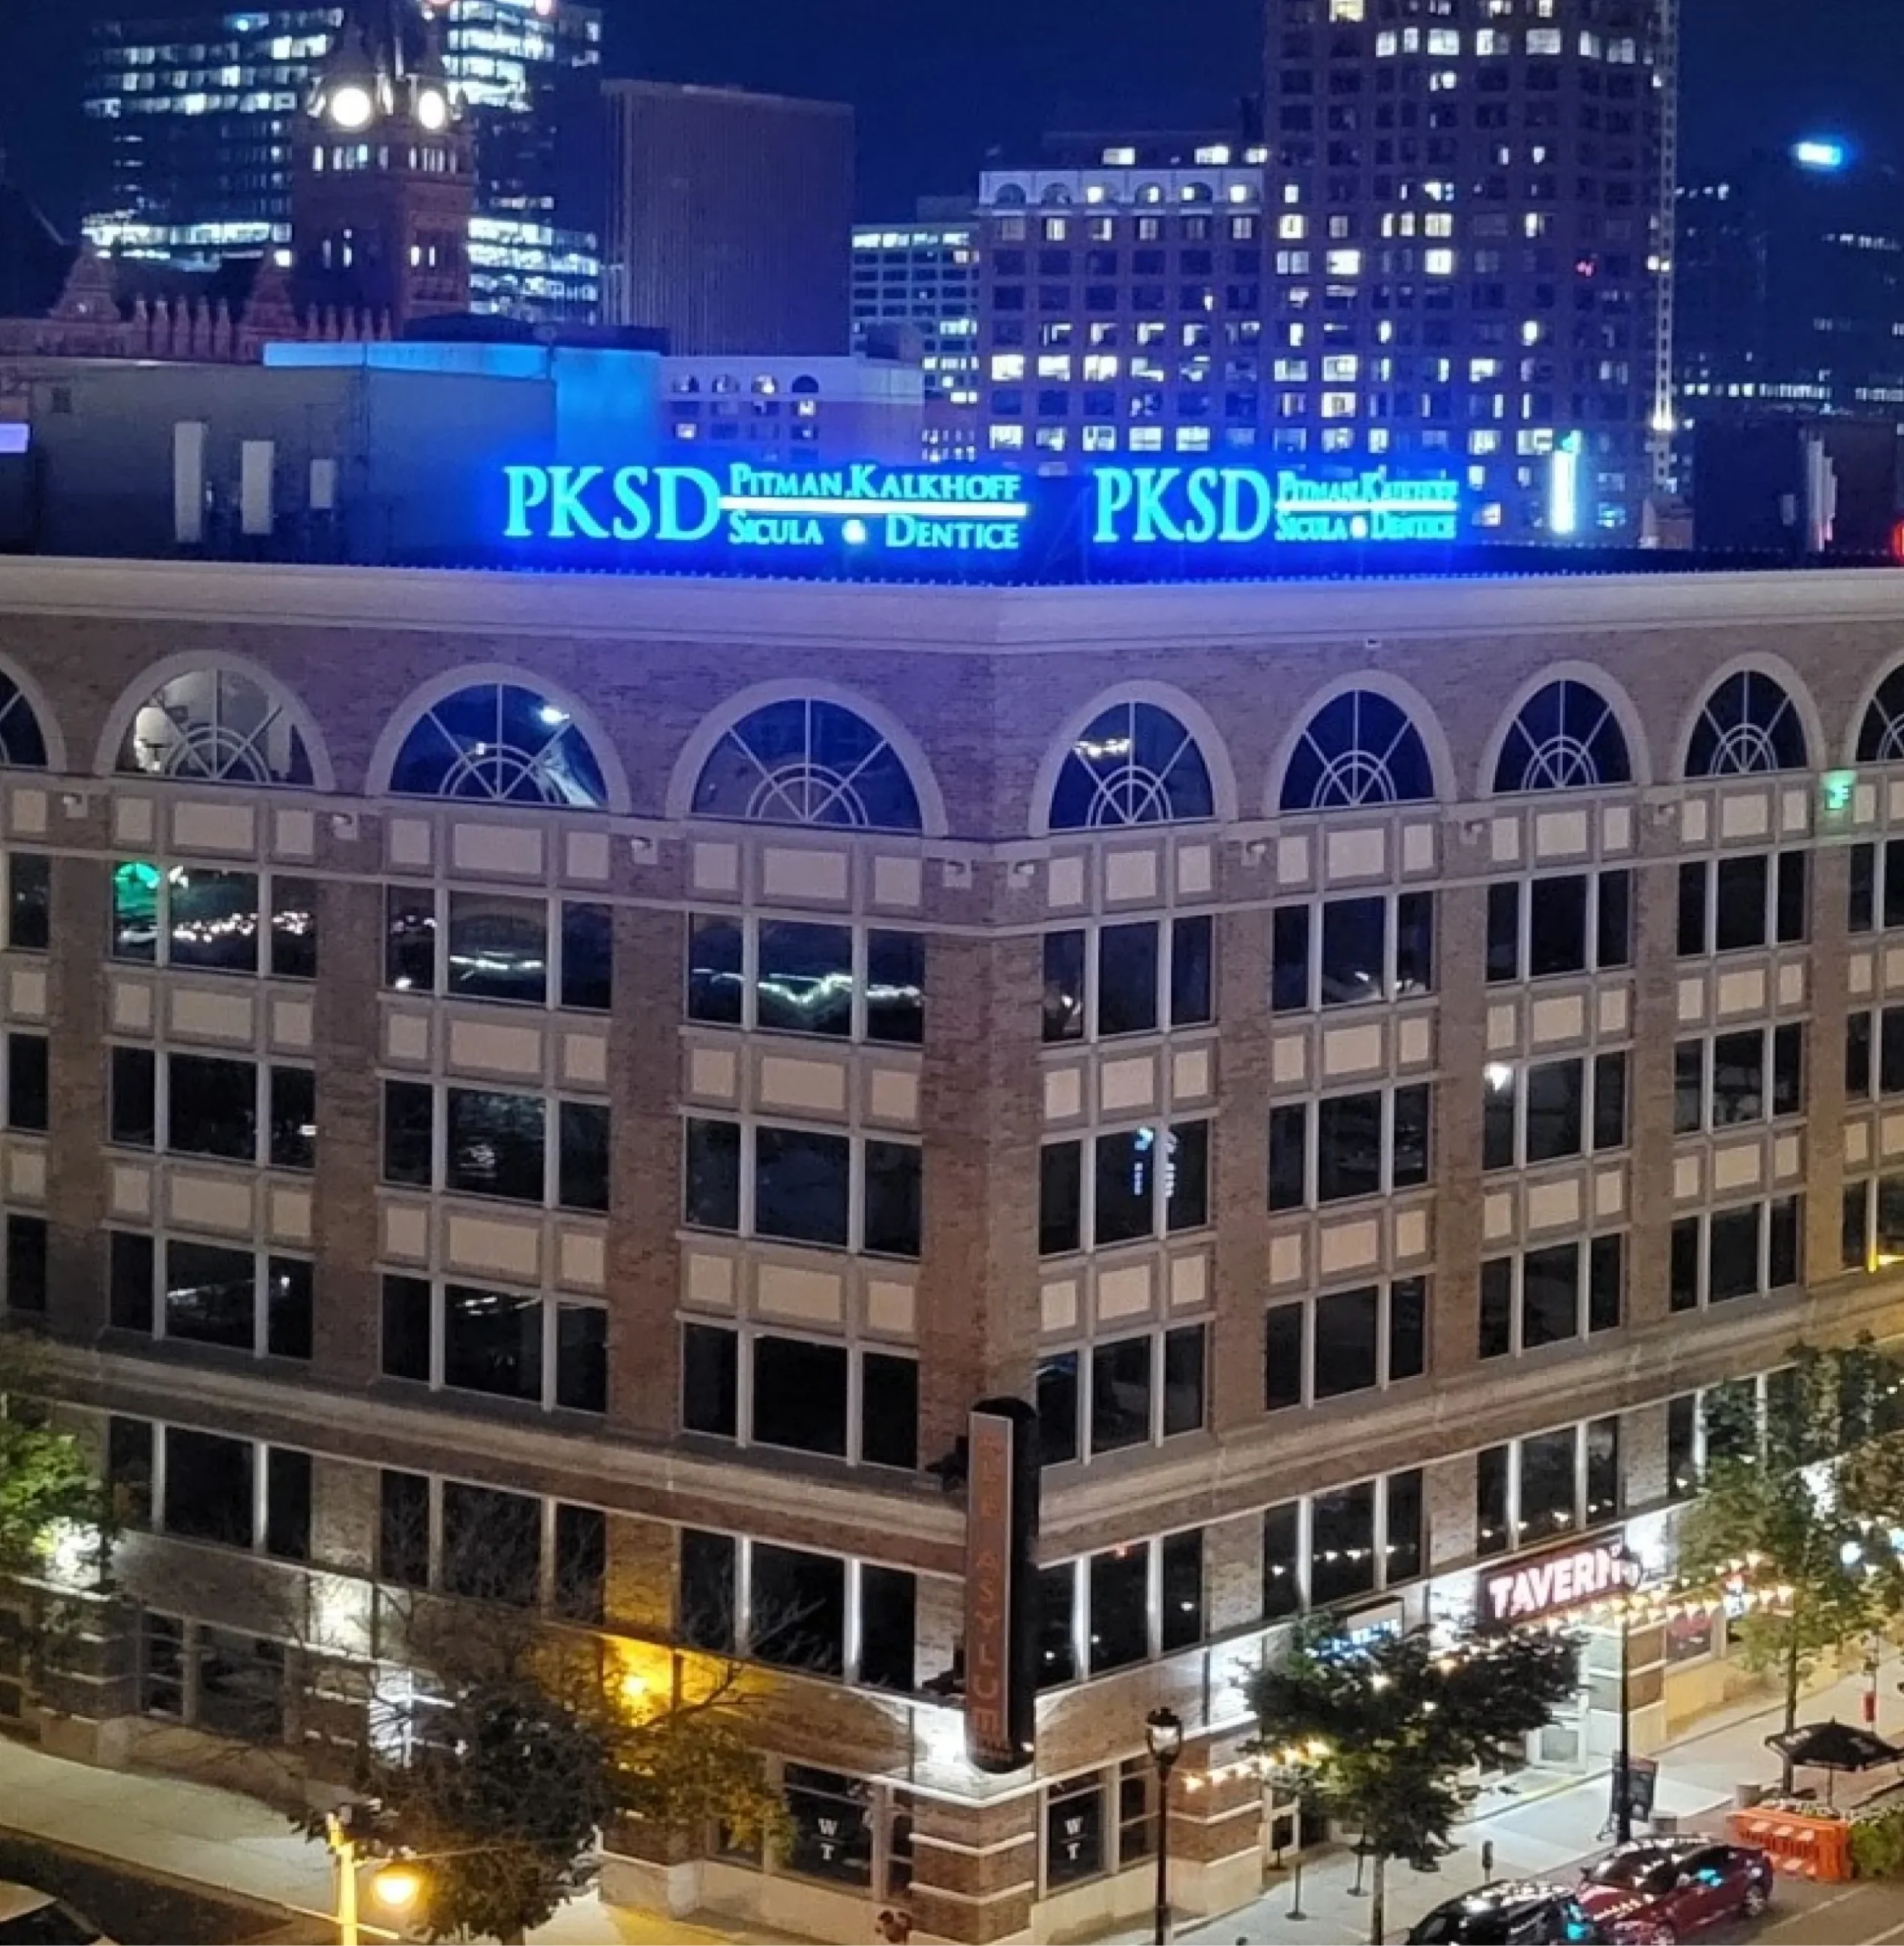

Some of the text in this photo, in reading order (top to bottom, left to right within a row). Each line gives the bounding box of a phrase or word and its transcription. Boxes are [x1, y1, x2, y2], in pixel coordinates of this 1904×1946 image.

[503, 466, 720, 540] PKSD
[850, 464, 1022, 501] KALKHOFF
[1093, 467, 1269, 542] PKSD
[728, 509, 825, 542] SICULA
[885, 514, 1019, 550] DENTICE
[1488, 1547, 1621, 1619] TAVERN
